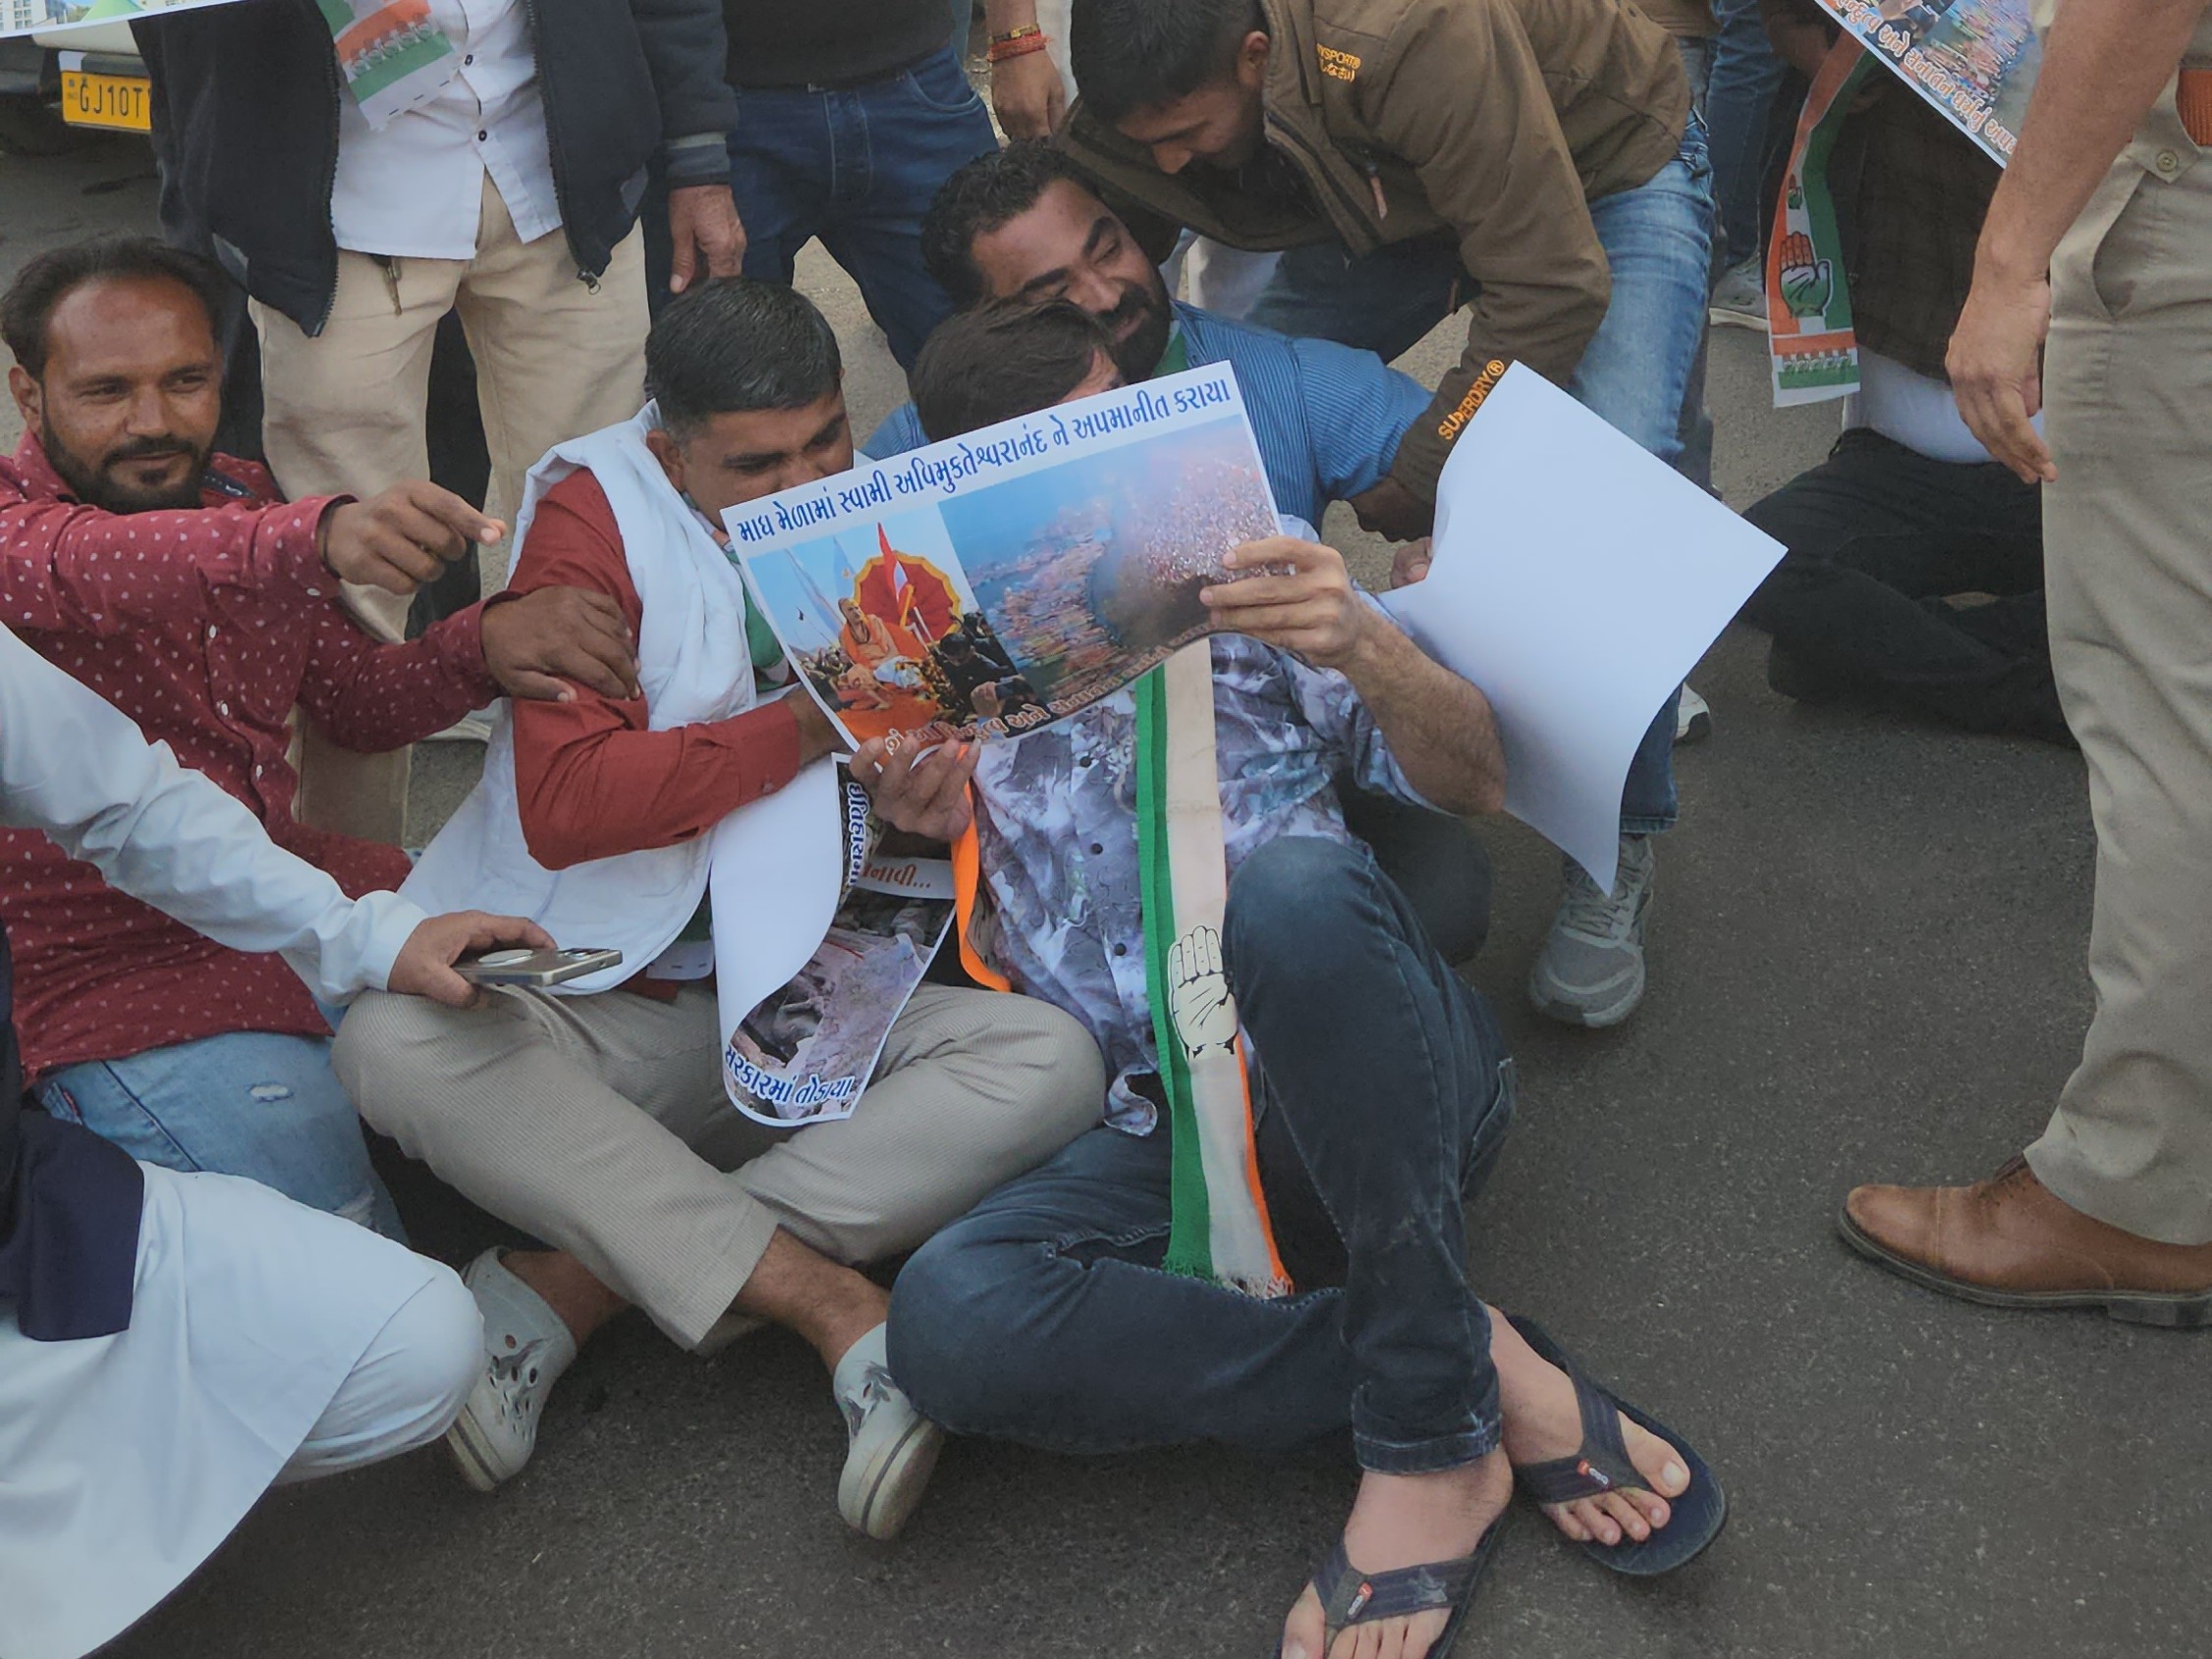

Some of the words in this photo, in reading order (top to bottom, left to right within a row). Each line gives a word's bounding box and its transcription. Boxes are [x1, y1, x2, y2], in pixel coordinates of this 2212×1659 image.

[80, 83, 151, 118] GJ10T
[737, 513, 775, 543] માઘ
[772, 485, 837, 531] મેળામાં
[838, 470, 893, 515] સ્વામી
[1049, 414, 1071, 447] ને
[1073, 389, 1170, 439] અપમાનીત
[1174, 379, 1232, 414] કરાયા
[796, 1075, 855, 1105] તોડાયા
